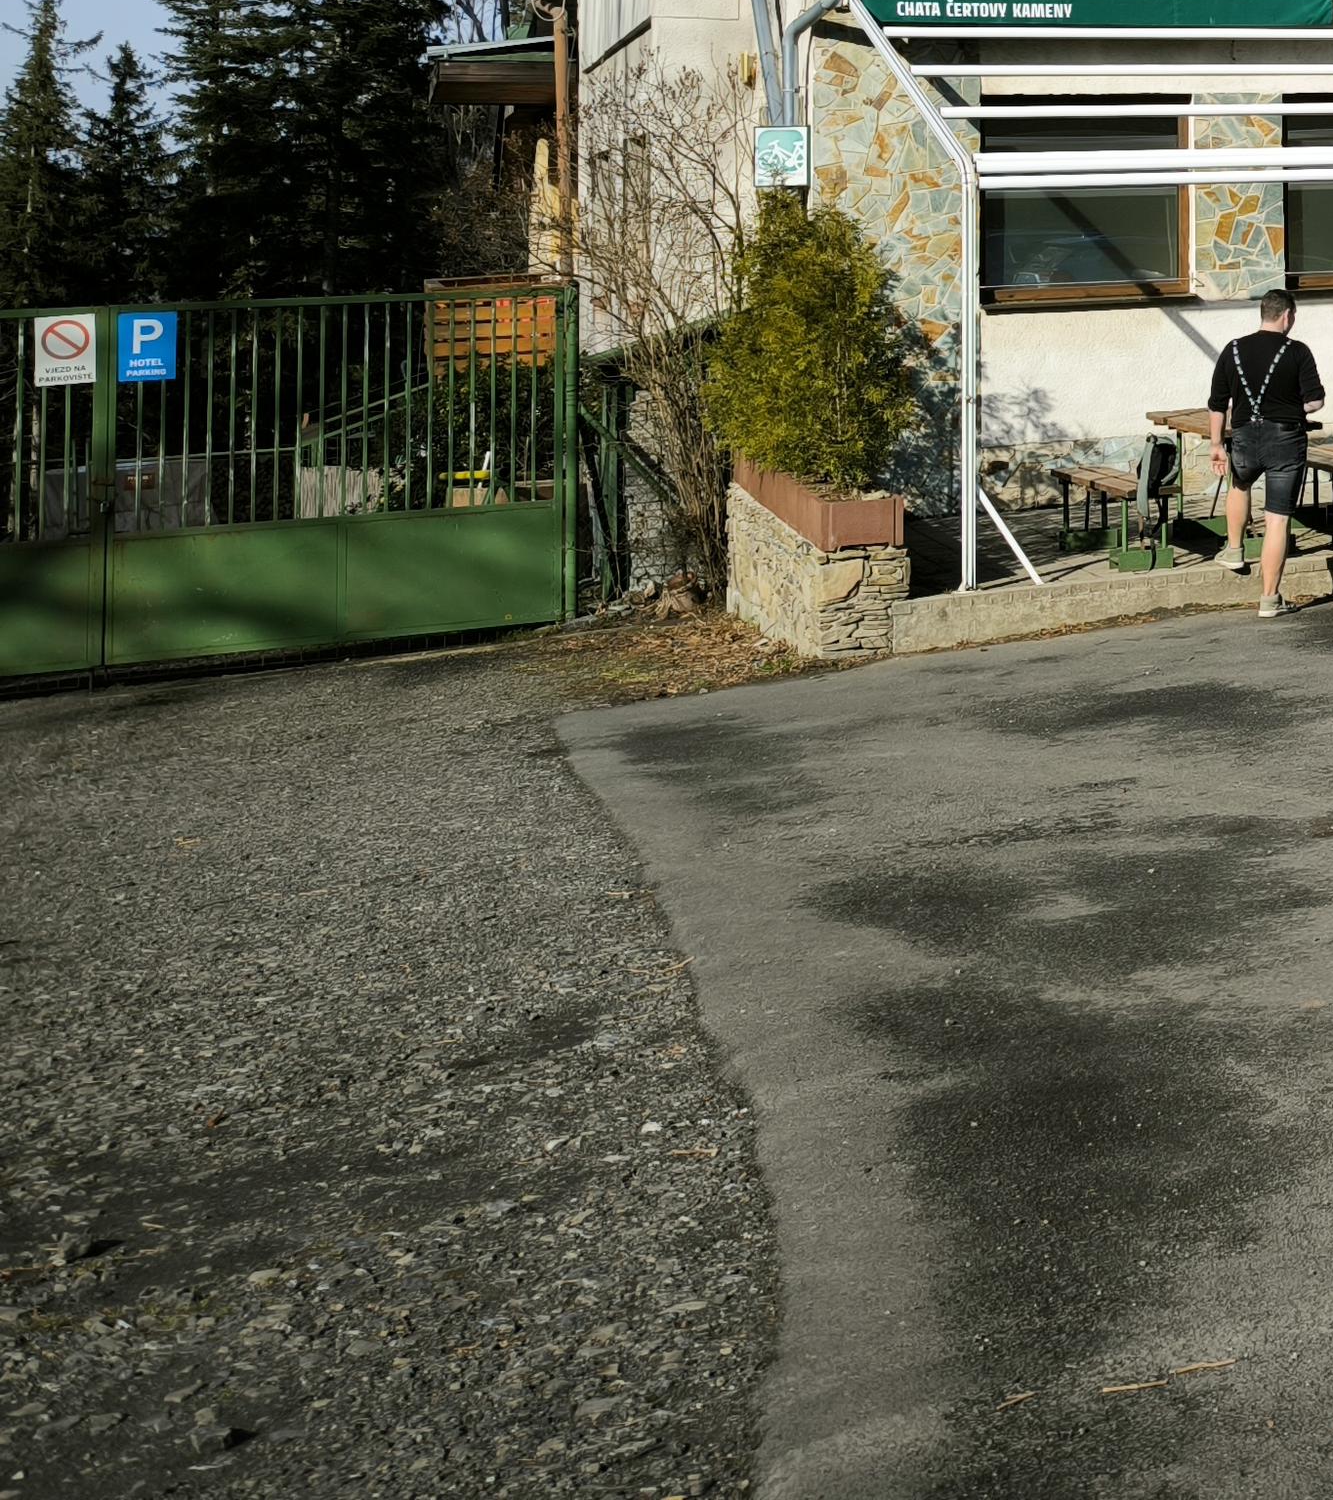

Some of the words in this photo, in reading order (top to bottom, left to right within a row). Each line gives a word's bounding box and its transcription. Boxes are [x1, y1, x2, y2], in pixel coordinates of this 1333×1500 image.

[896, 1, 941, 18] CHATA
[1012, 2, 1073, 19] KAMENY
[132, 318, 164, 355] P
[129, 358, 164, 368] HOTEL
[45, 366, 72, 374] VJEZD
[126, 368, 167, 377] PARKING
